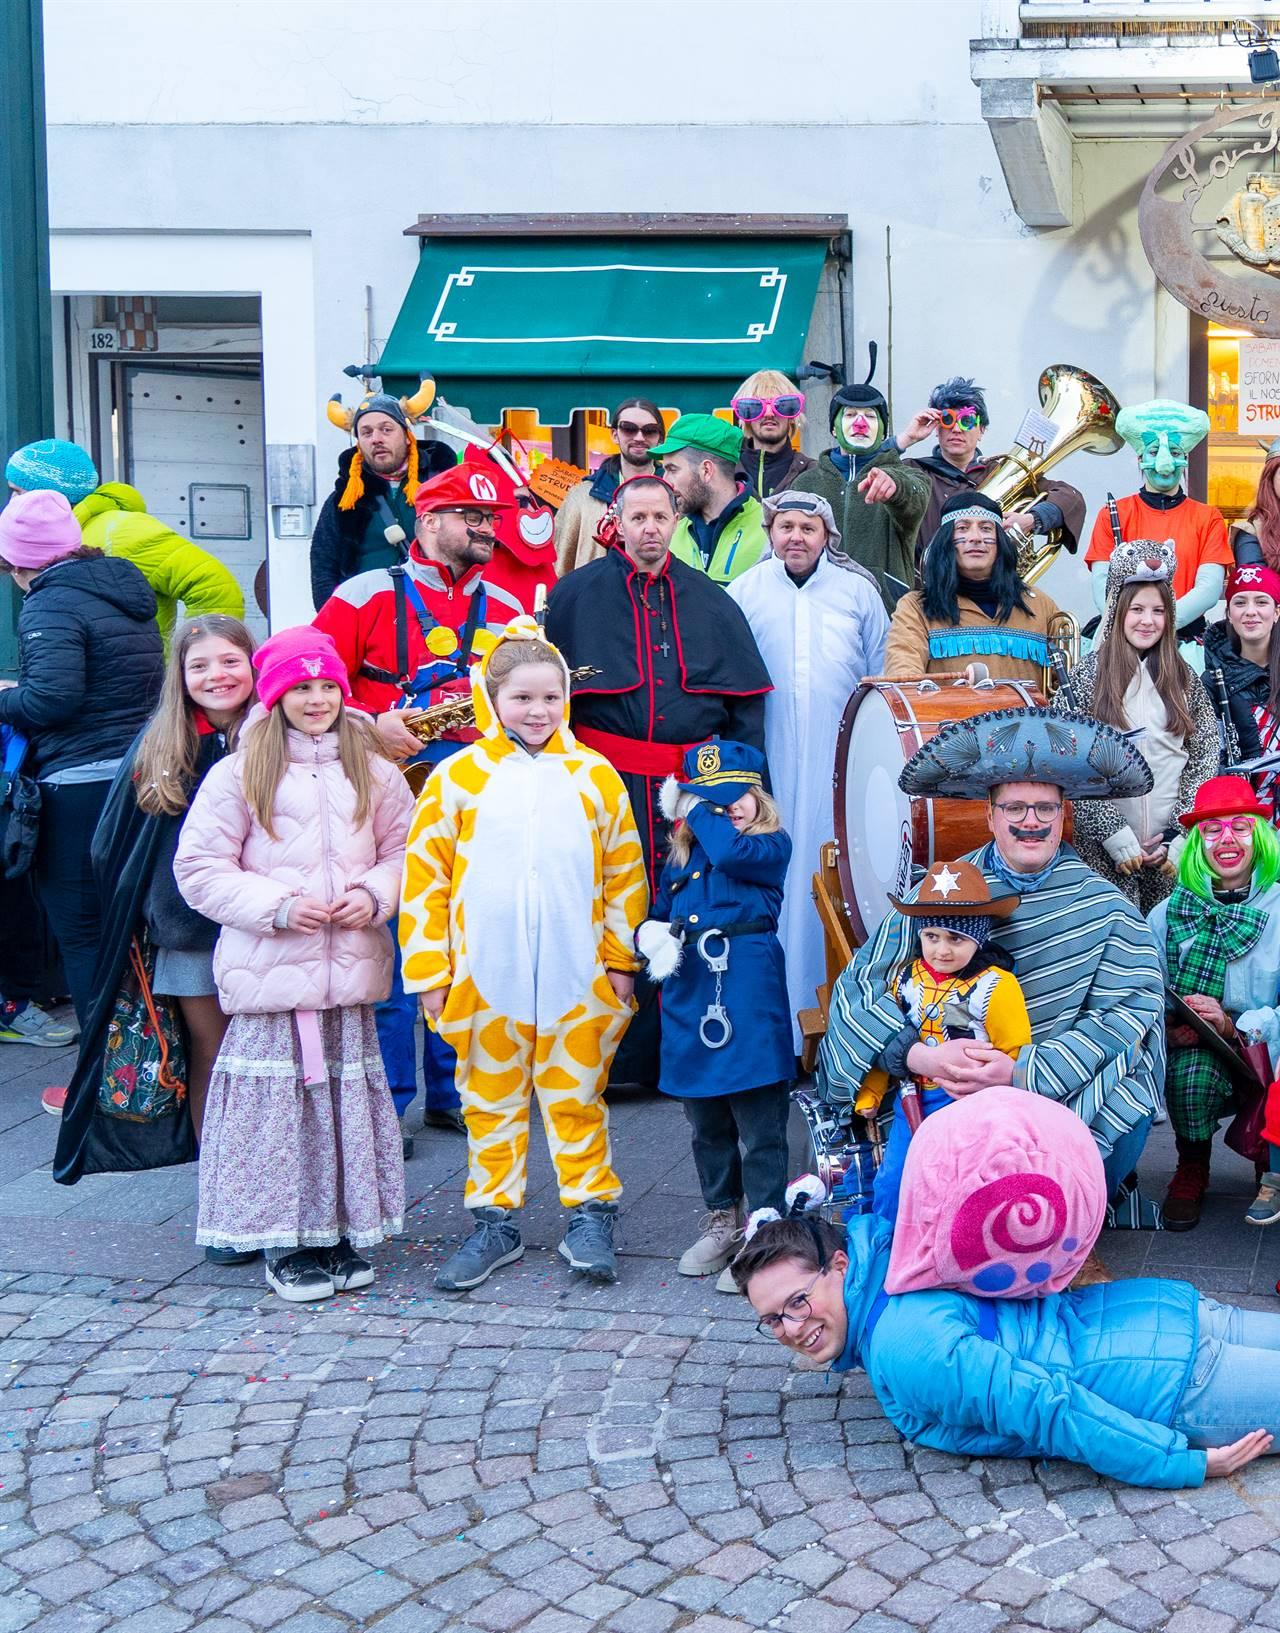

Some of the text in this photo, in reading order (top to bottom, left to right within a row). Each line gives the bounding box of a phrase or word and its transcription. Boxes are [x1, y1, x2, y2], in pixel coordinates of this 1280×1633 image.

[1172, 144, 1240, 200] La
[1200, 291, 1271, 322] gusto
[91, 333, 113, 349] 182
[1249, 388, 1258, 400] IL
[475, 475, 494, 499] M
